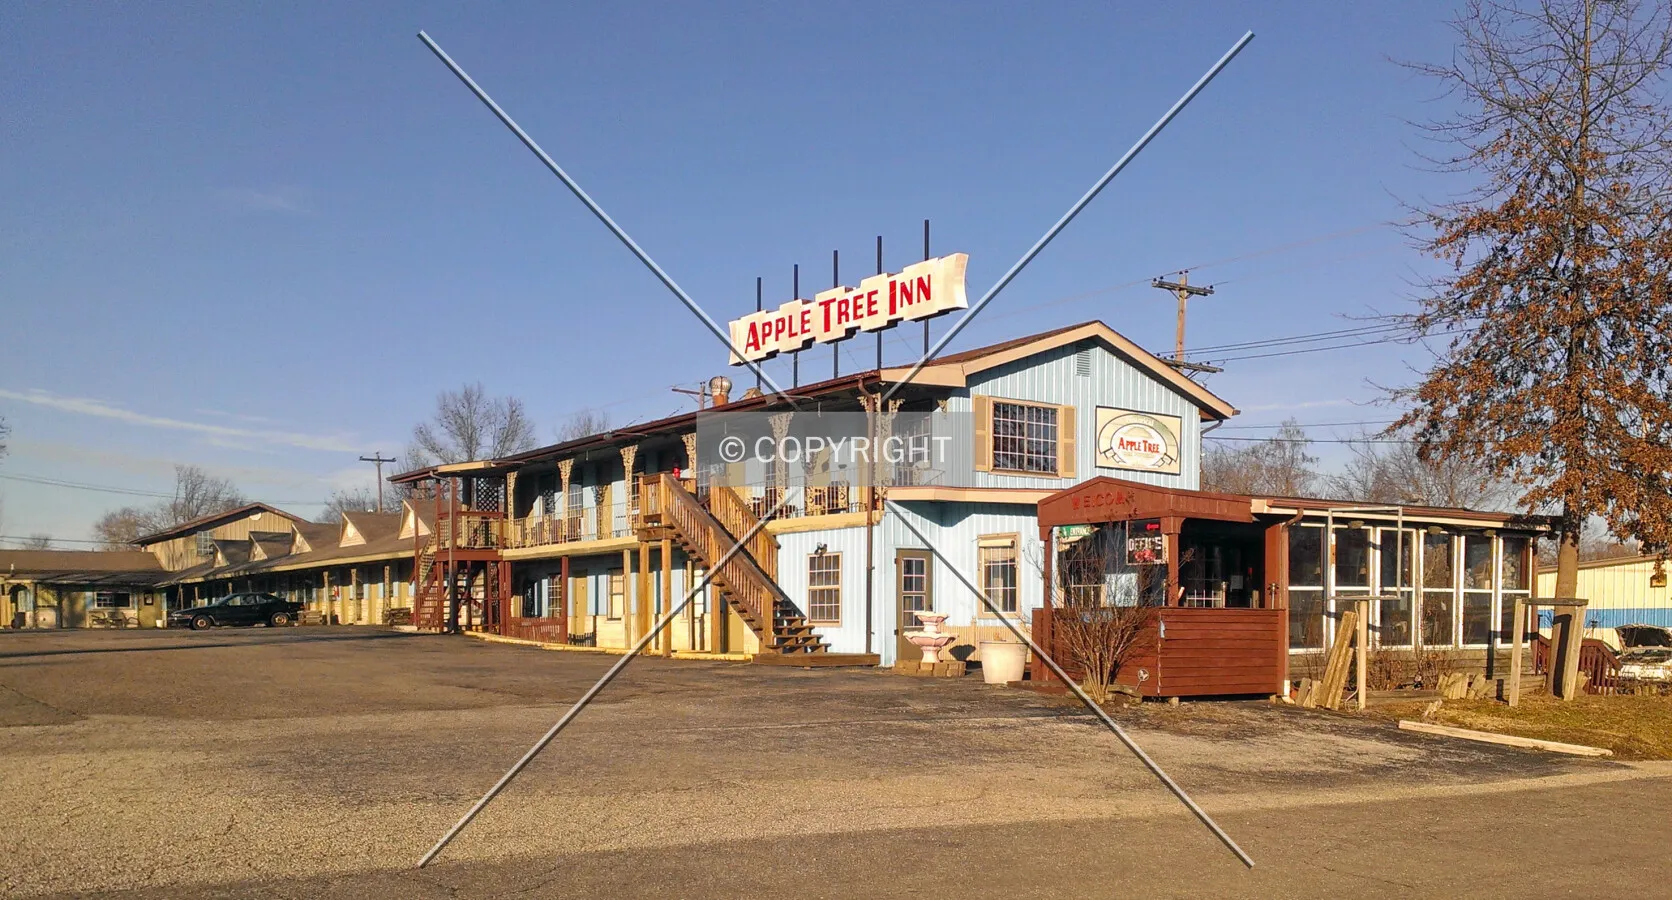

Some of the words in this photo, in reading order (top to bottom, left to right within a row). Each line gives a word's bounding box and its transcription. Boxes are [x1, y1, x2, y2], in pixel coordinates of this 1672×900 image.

[745, 309, 811, 353] APPLE
[819, 289, 879, 333] TREE
[889, 274, 931, 315] INN
[1118, 437, 1141, 451] APPLE
[1142, 440, 1160, 453] TREE
